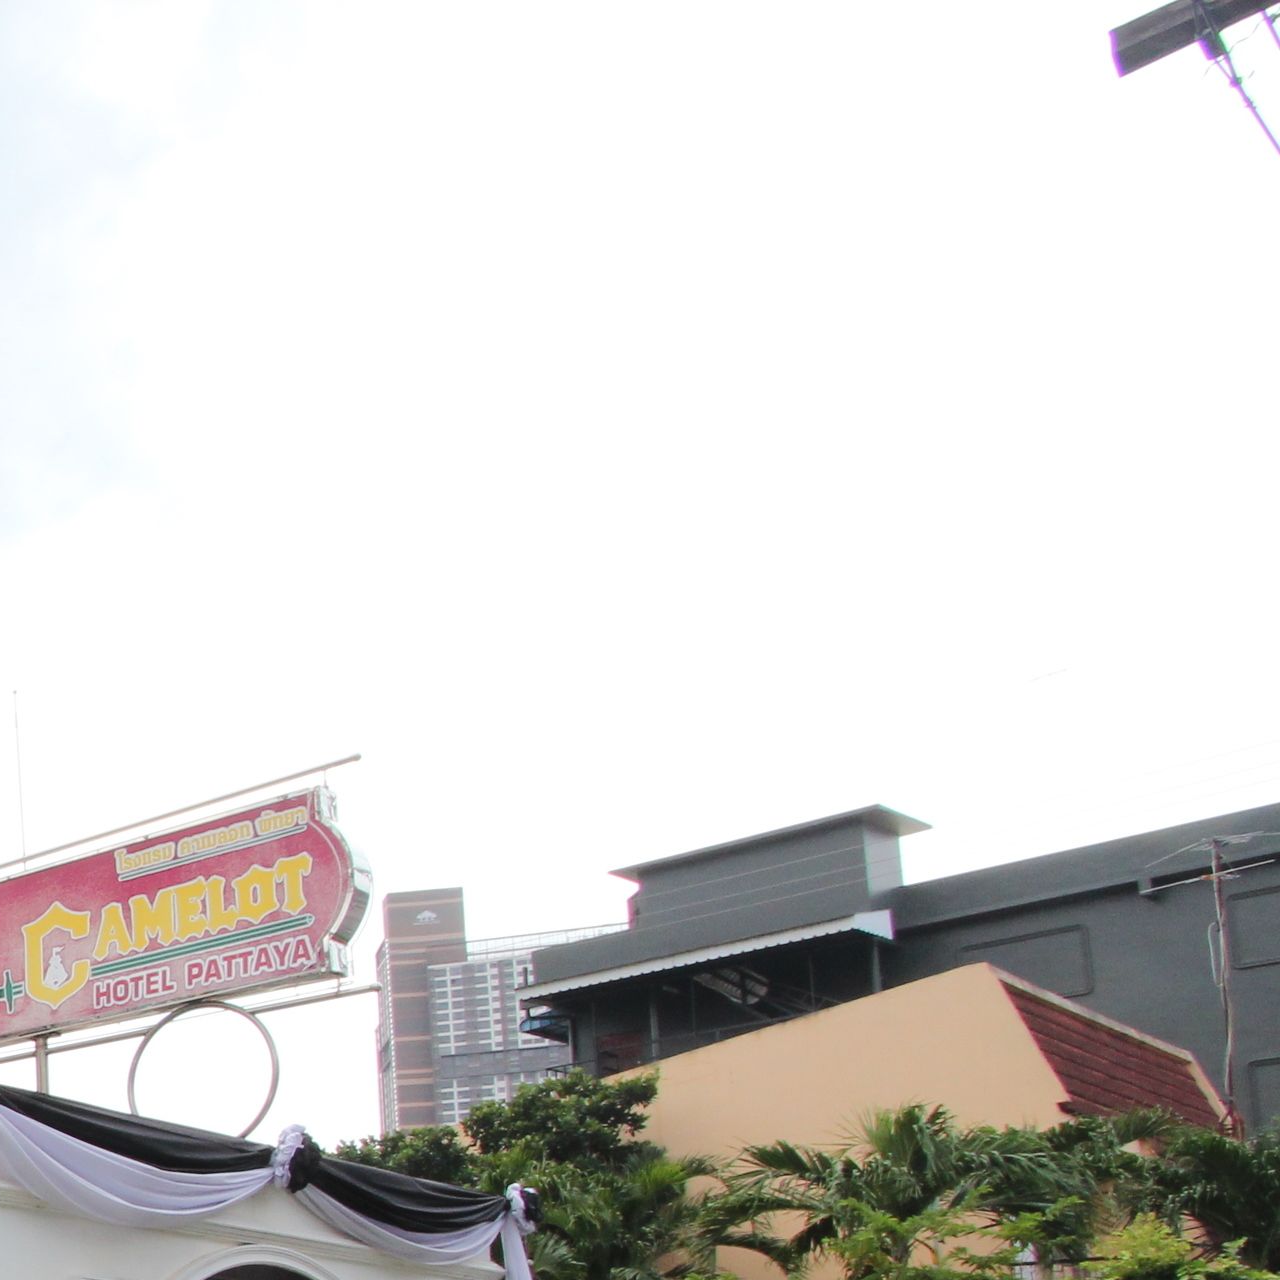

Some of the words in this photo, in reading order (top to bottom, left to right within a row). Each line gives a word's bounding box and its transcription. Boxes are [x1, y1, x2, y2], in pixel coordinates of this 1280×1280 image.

[116, 844, 174, 873] โรงแรม
[257, 808, 307, 834] พัทยา
[23, 853, 312, 1008] CAMELOT
[94, 967, 175, 1008] HOTEL
[186, 938, 312, 988] PATTAYA
